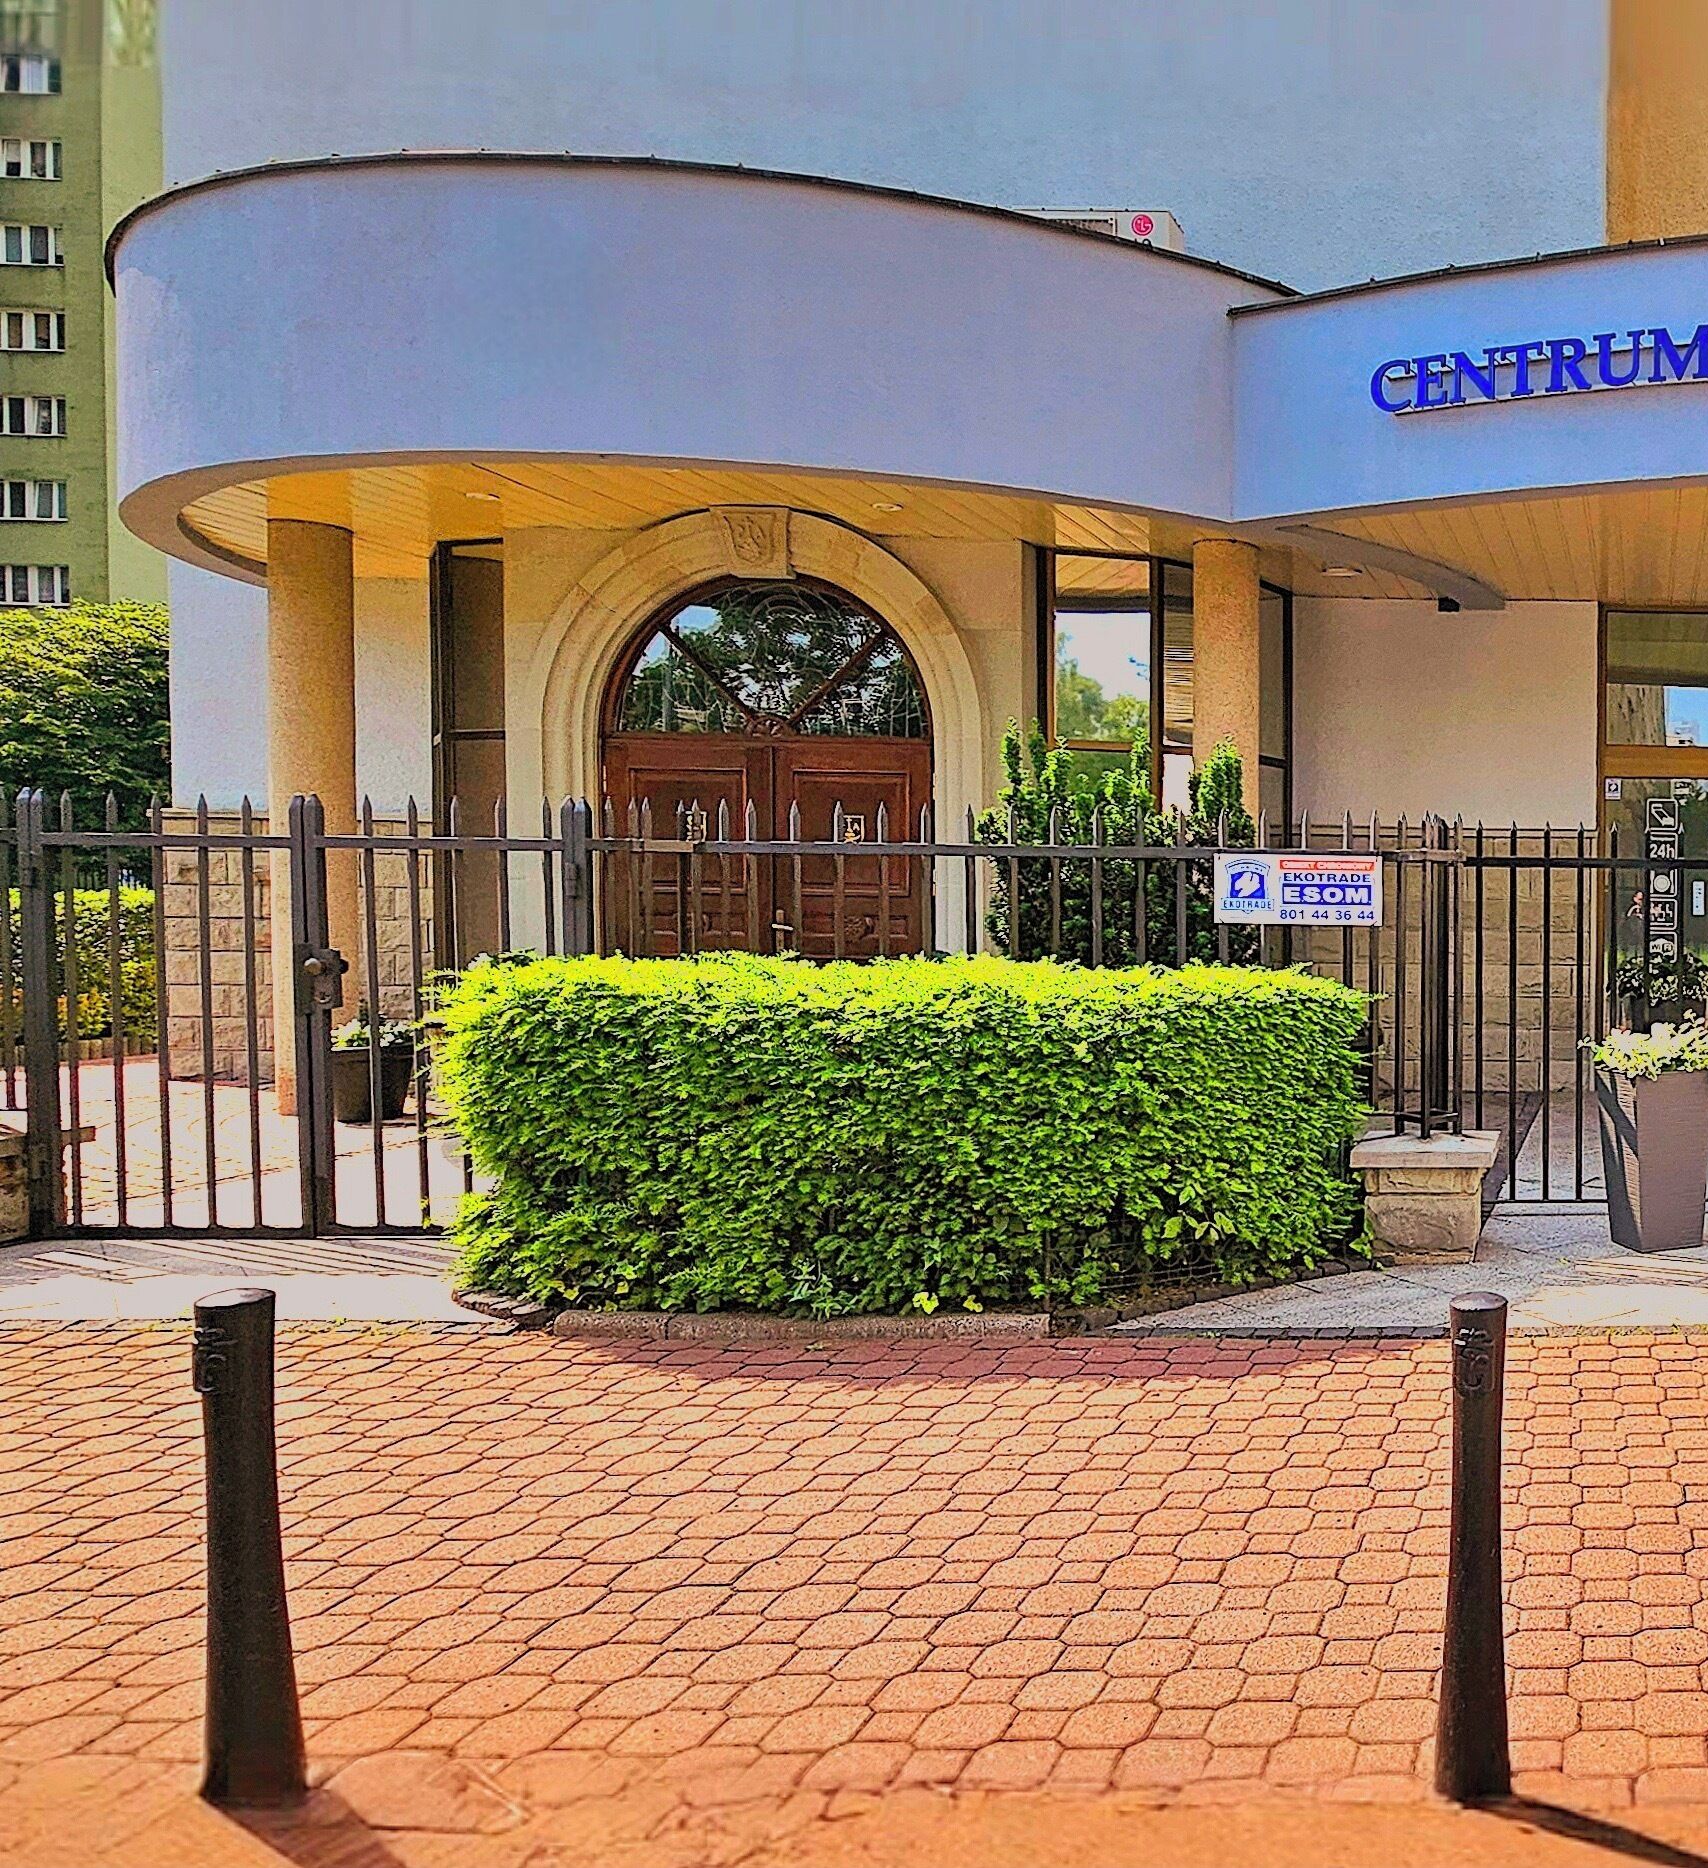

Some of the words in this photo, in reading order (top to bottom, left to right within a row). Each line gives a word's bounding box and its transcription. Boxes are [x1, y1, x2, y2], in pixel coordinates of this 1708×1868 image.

[1649, 843, 1675, 859] 24h
[1283, 872, 1371, 883] EKOTRADE
[1223, 900, 1272, 909] EKOTRADE
[1280, 909, 1304, 920] 801
[1311, 910, 1329, 920] 44
[1335, 910, 1352, 921] 36
[1357, 910, 1375, 920] 44
